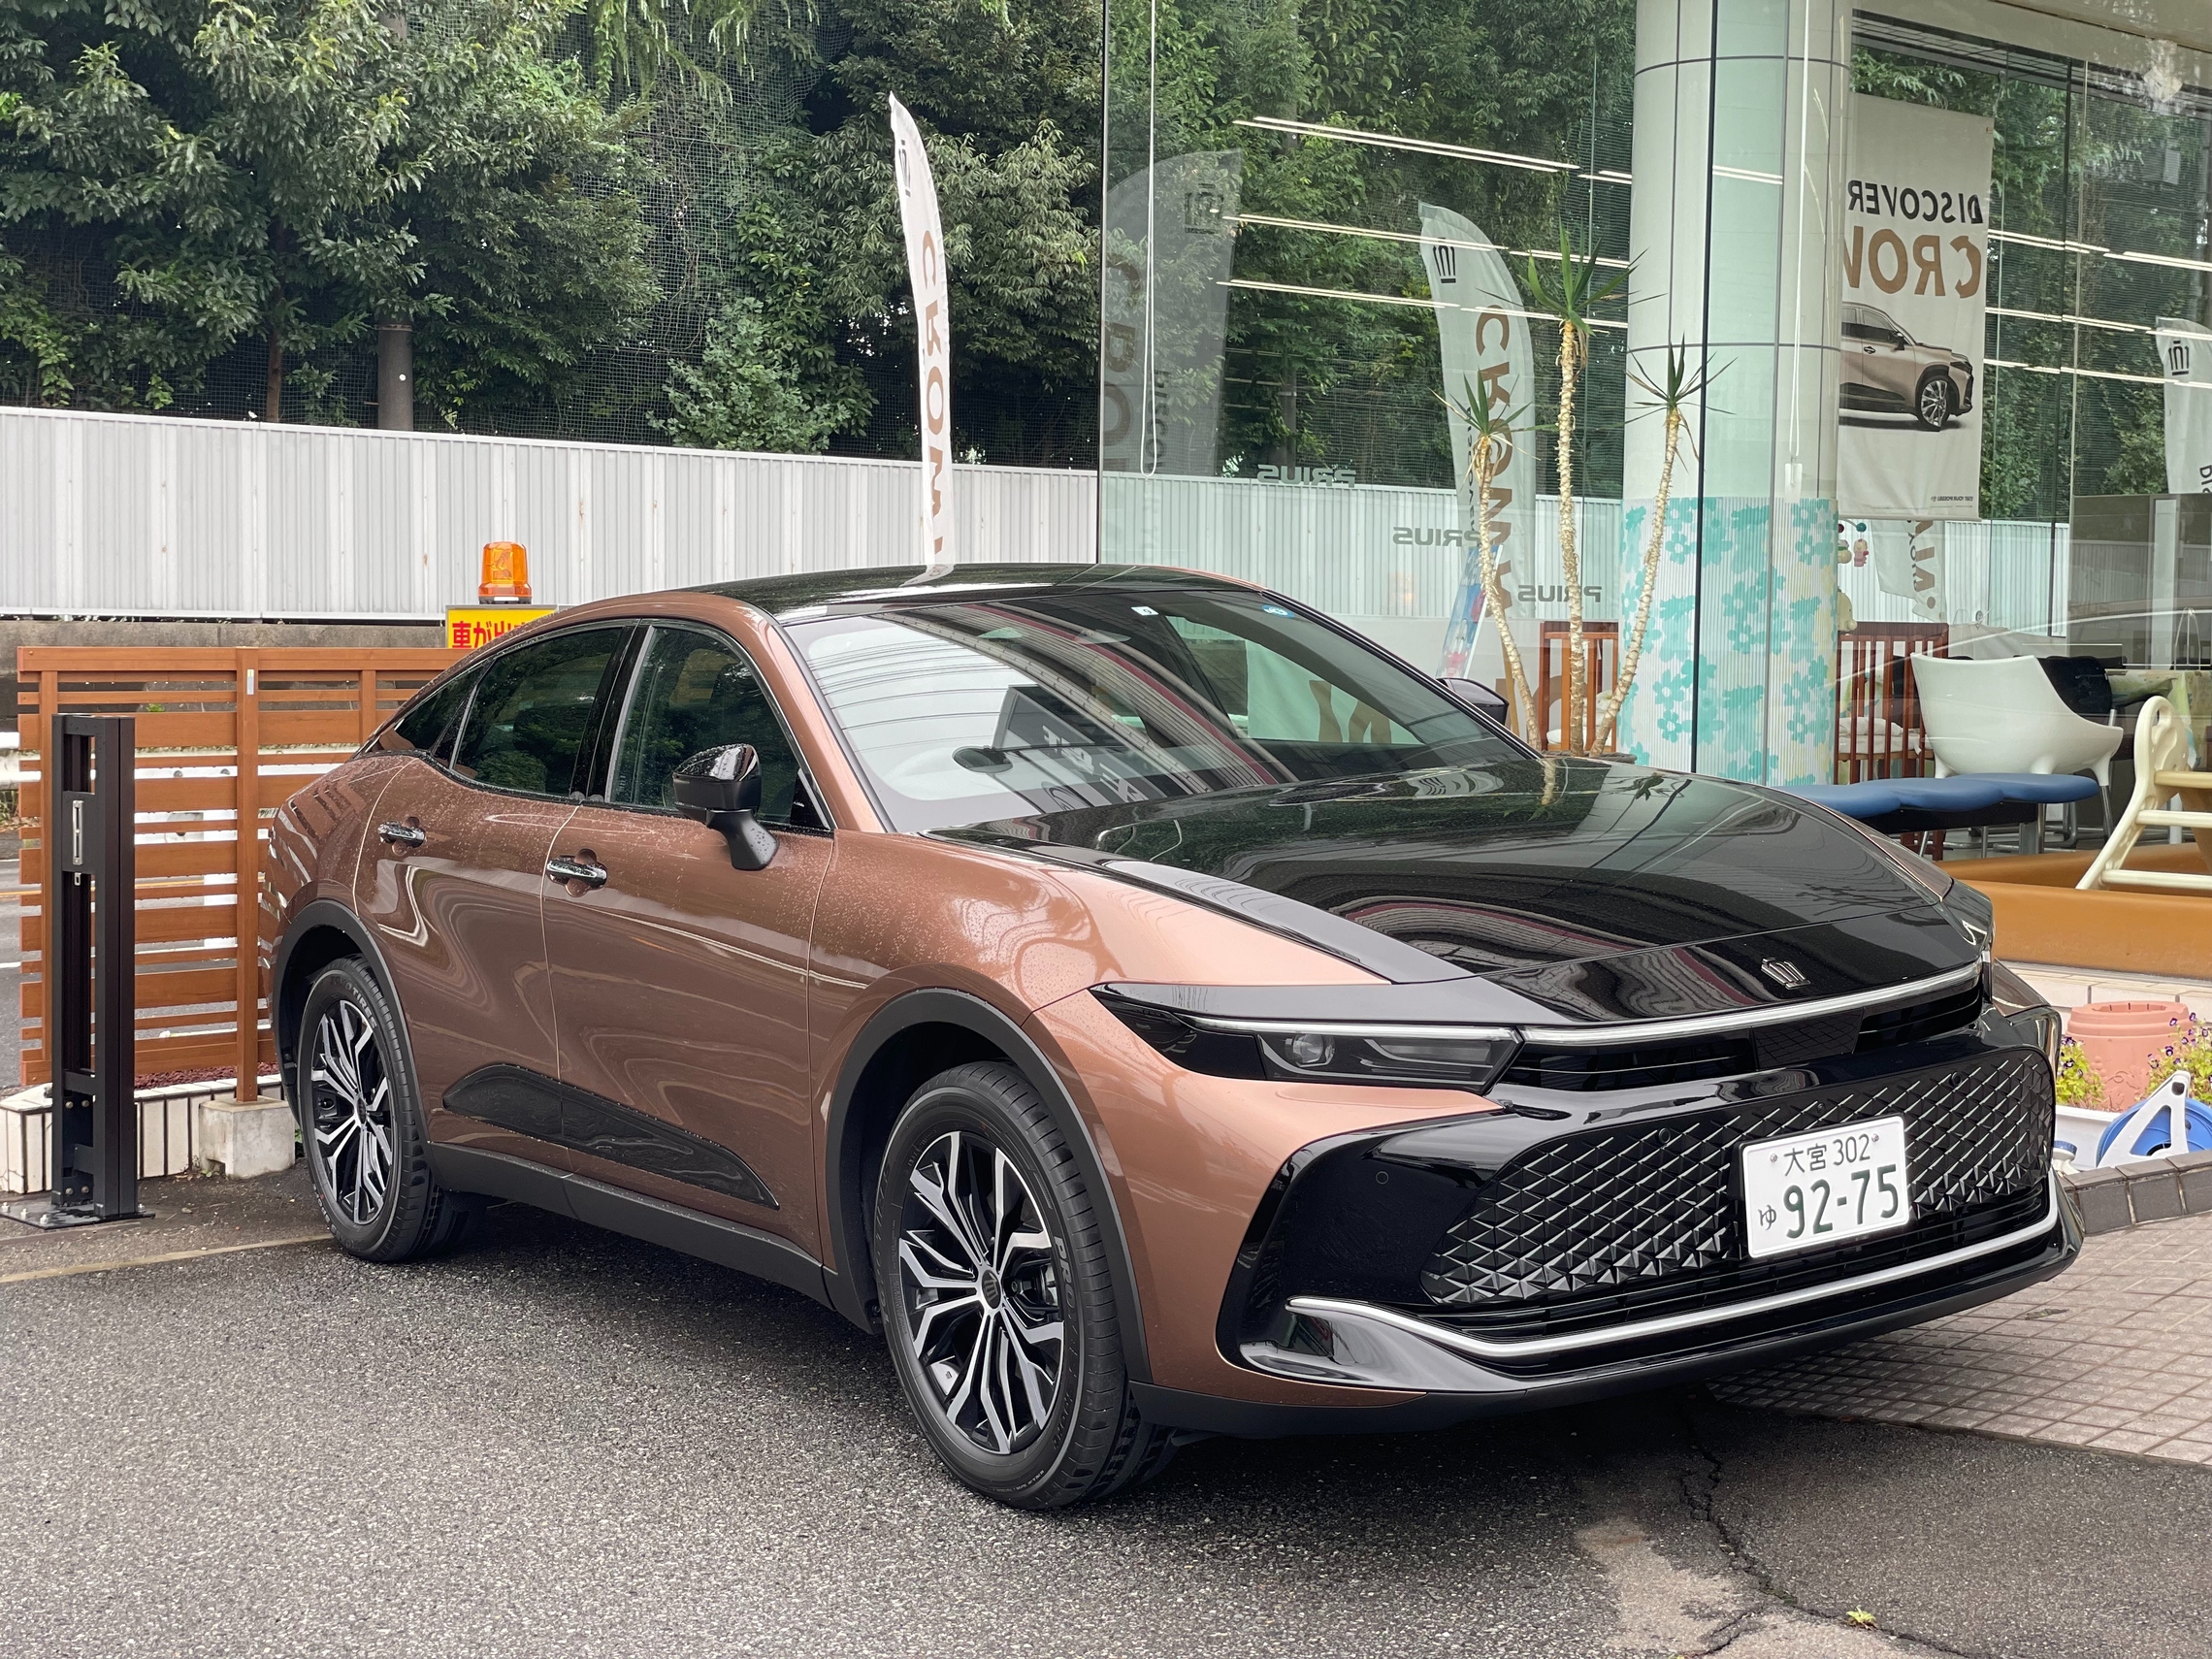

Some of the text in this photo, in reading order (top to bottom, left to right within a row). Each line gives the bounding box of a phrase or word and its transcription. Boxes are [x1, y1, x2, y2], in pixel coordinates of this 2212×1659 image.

[1783, 1133, 1870, 1177] 大宮 302
[1758, 1163, 1899, 1239] ゆ 92-75
